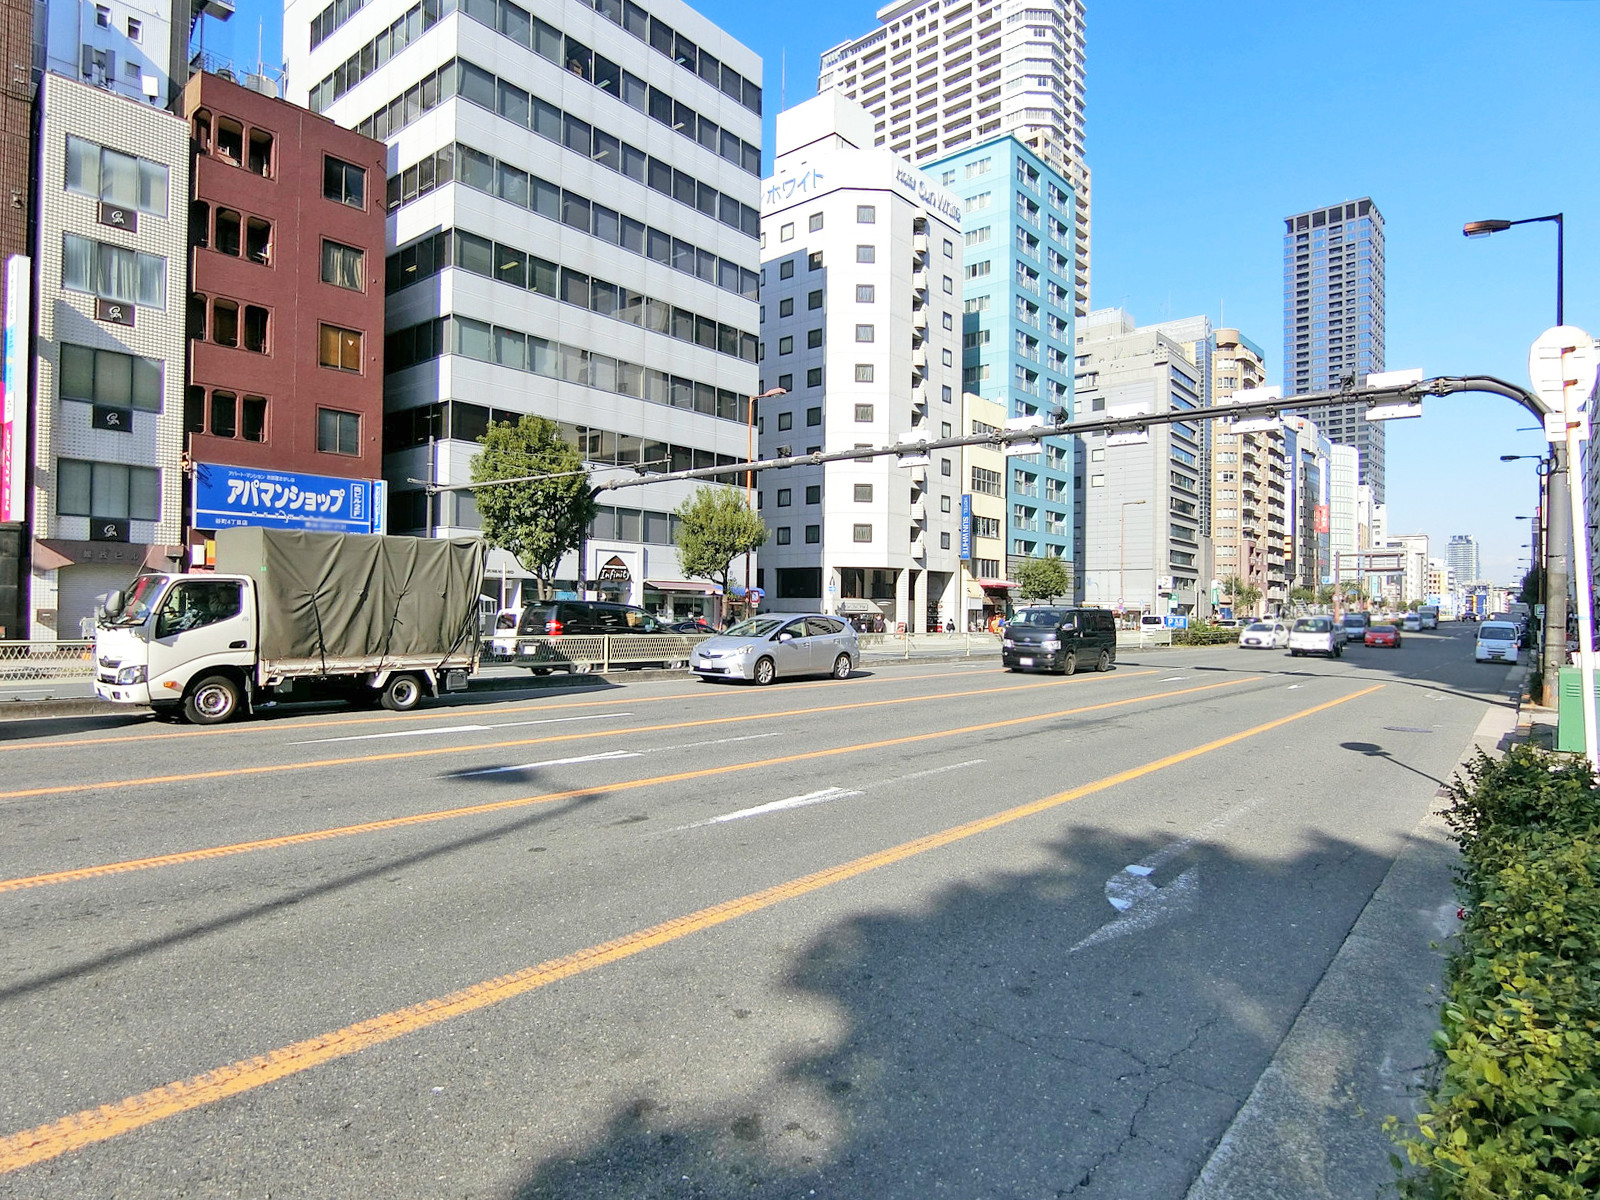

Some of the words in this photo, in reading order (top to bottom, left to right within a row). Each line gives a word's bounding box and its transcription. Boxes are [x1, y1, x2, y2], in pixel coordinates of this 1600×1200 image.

[228, 479, 345, 513] アパマンショップ
[600, 569, 631, 581] Infinity
